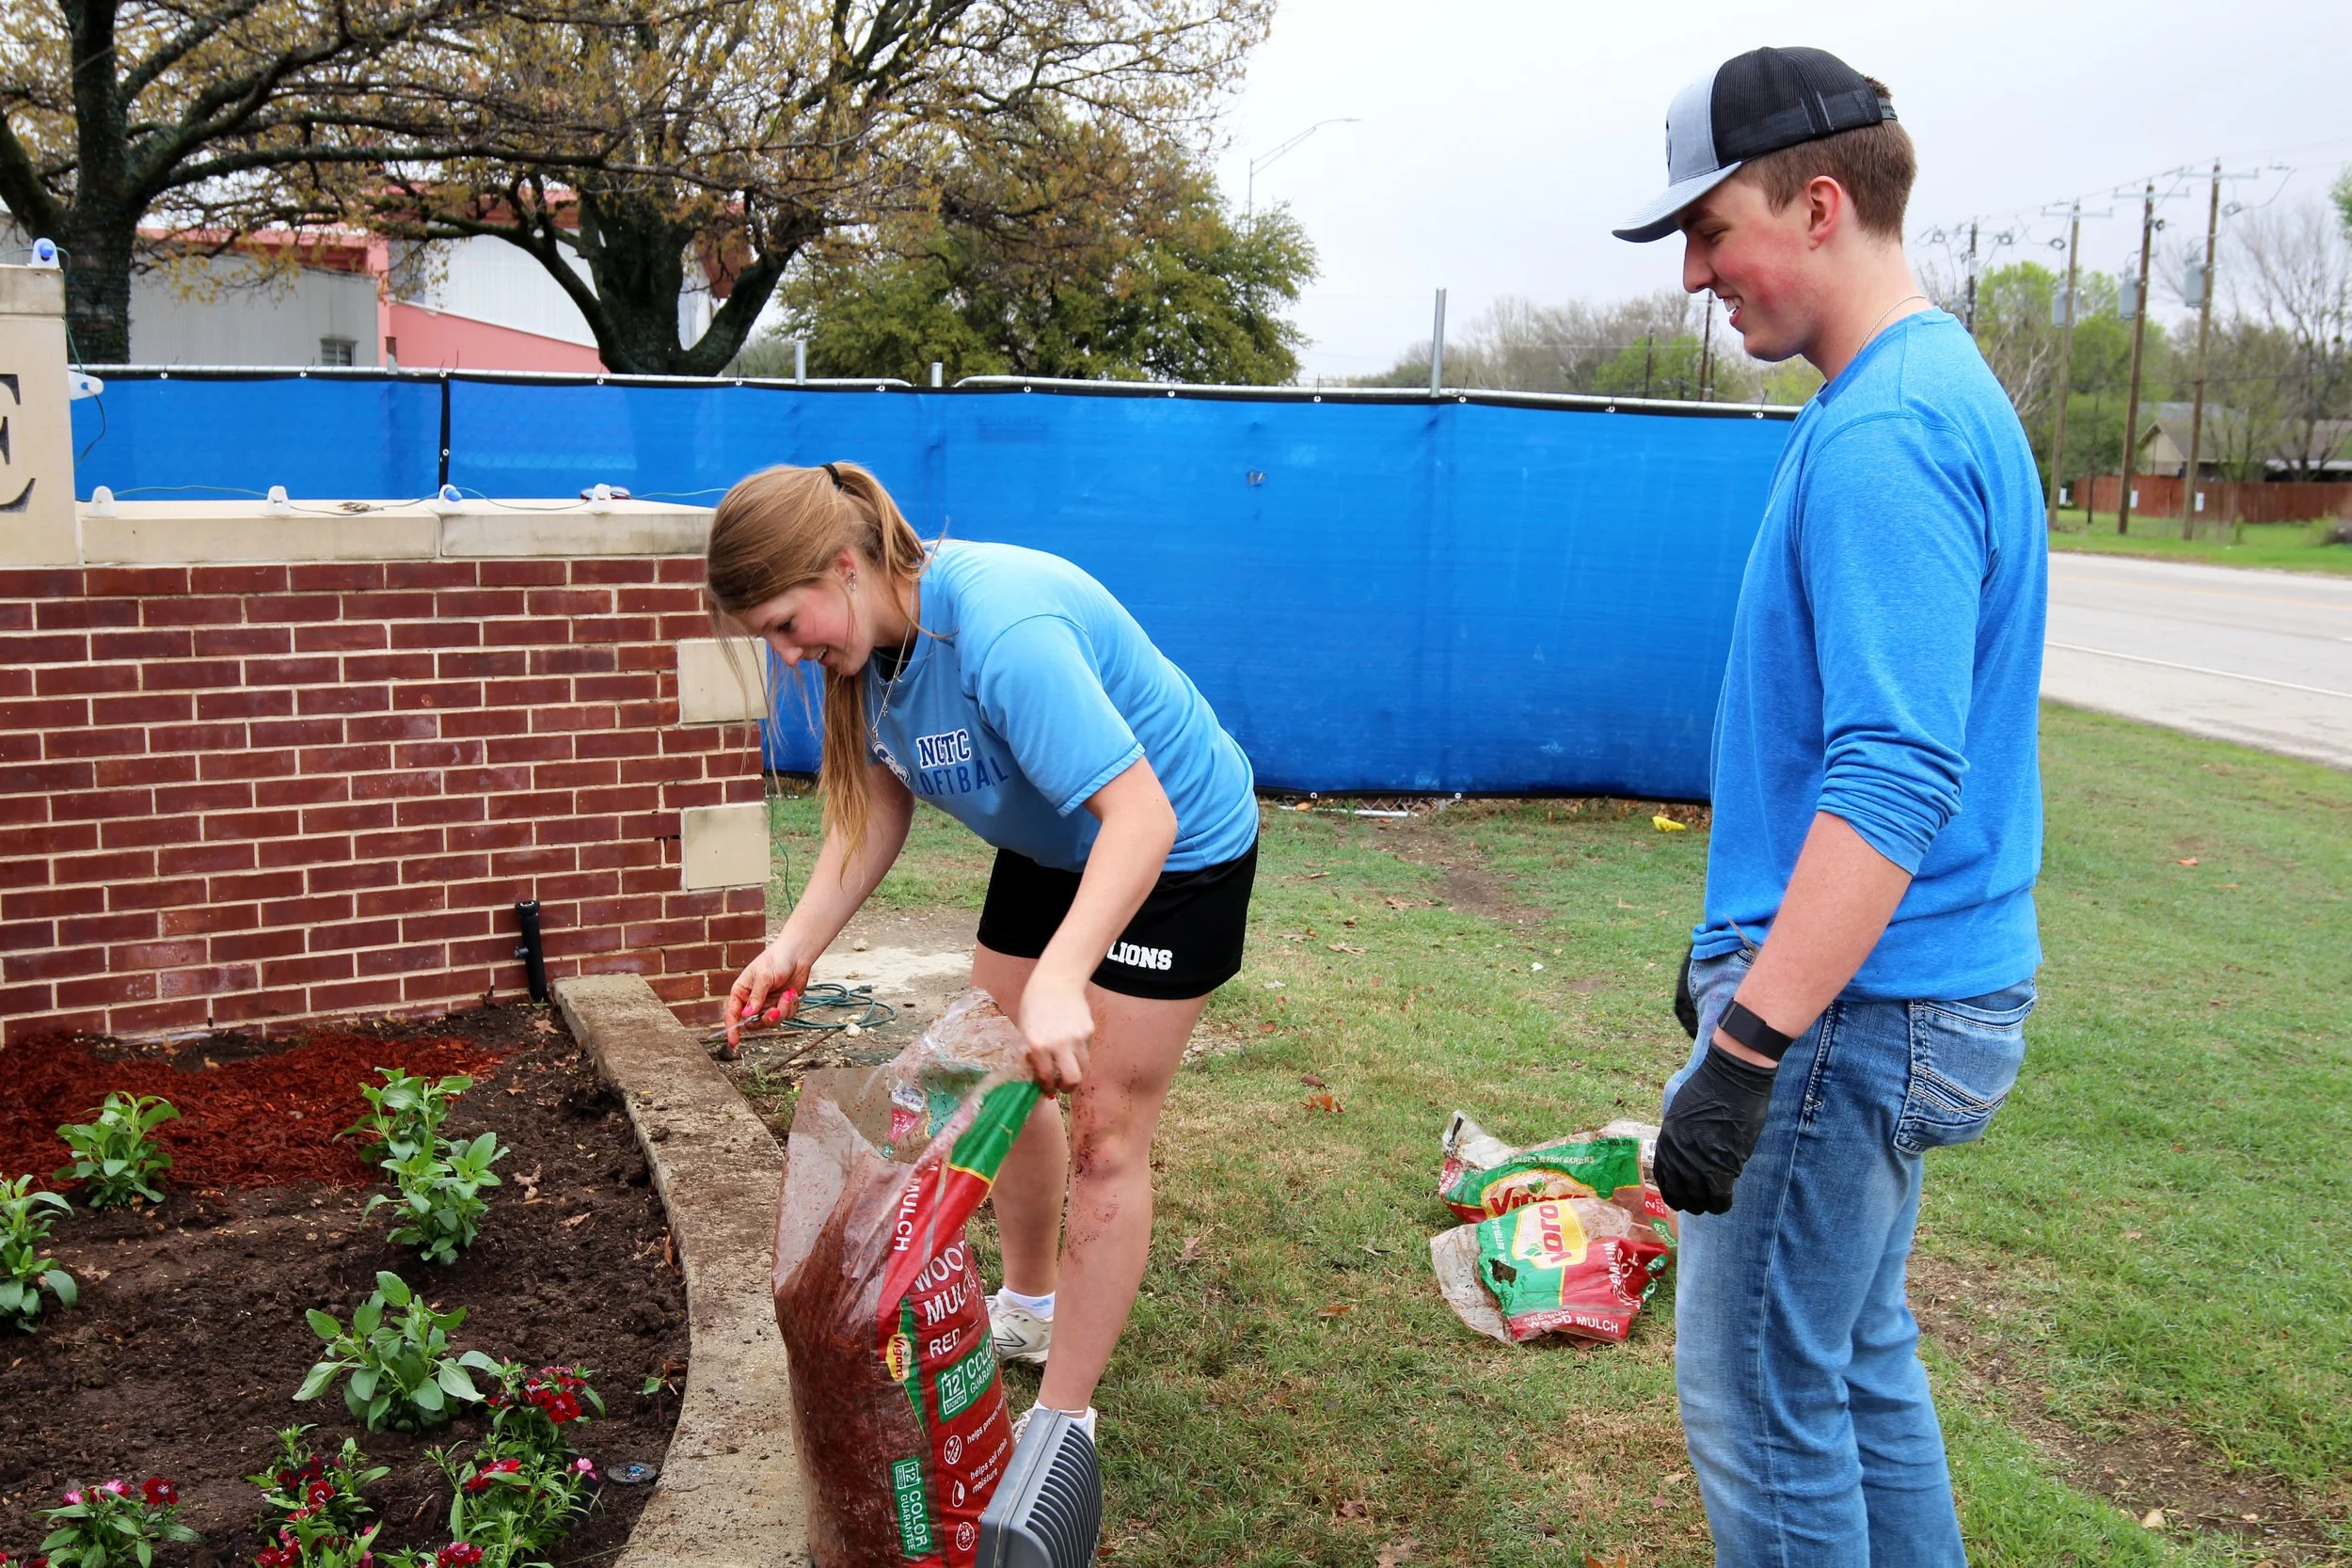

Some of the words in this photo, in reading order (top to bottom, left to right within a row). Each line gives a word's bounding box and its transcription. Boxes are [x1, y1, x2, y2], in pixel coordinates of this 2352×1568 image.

[916, 729, 971, 768] NCTC
[1106, 941, 1172, 970] LIONS
[1527, 1315, 1572, 1329] WOOD
[1575, 1317, 1618, 1333] MULCH
[929, 1328, 961, 1358] RED
[966, 1335, 993, 1380] COLO
[945, 1373, 961, 1397] 12
[946, 1394, 965, 1412] MONTH
[966, 1428, 983, 1445] helps
[907, 1466, 915, 1481] 12
[970, 1462, 988, 1481] helps
[988, 1451, 998, 1467] soil
[973, 1467, 998, 1494] moisture
[900, 1494, 915, 1551] GUARANTEE
[910, 1490, 928, 1547] COLOR
[961, 1528, 970, 1541] 24
